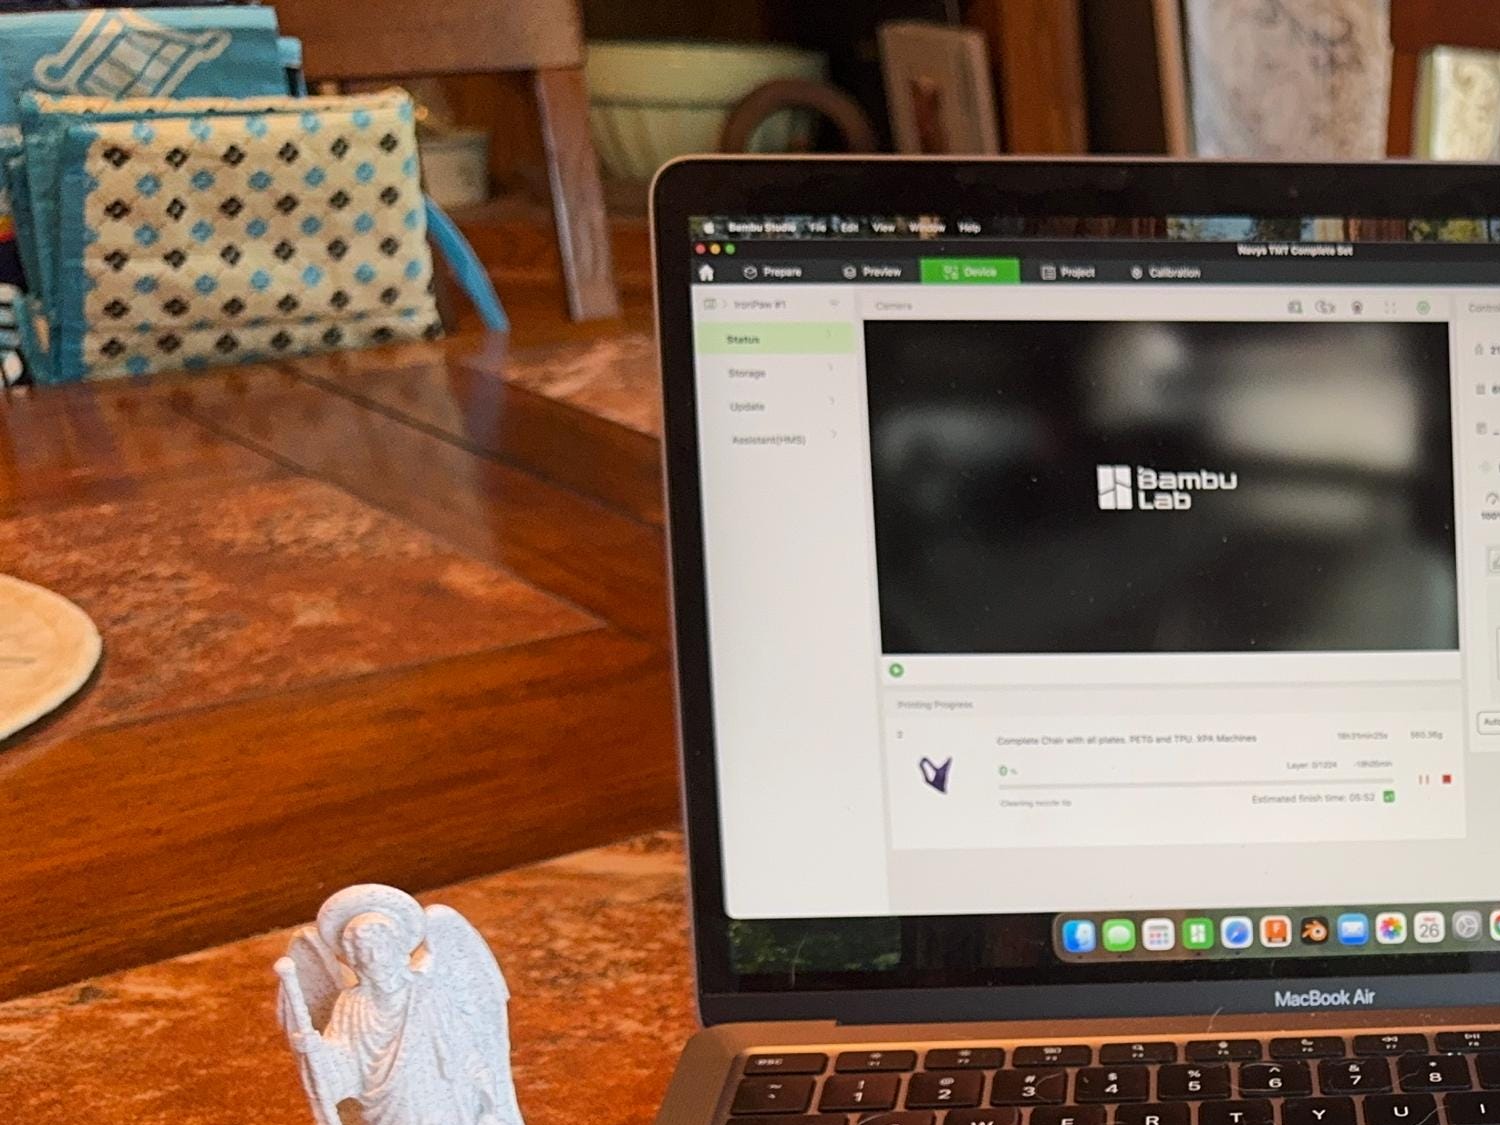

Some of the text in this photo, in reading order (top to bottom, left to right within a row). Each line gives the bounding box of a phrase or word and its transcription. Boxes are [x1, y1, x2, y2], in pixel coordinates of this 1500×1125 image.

[728, 222, 797, 232] Bambu Studio
[809, 223, 827, 232] File
[841, 223, 859, 232] Edit
[872, 223, 896, 232] View
[909, 223, 946, 232] Window
[958, 223, 982, 233] Help
[763, 266, 802, 278] Prepare
[862, 266, 902, 278] Preview
[964, 266, 997, 277] Device
[1060, 266, 1096, 279] Project
[1150, 266, 1201, 278] Calibration
[726, 335, 760, 345] Status
[728, 368, 767, 379] Storage
[730, 402, 765, 412] Update
[1137, 466, 1237, 490] Bambu
[1138, 490, 1192, 510] Lab
[996, 735, 1039, 746] Complete
[1041, 735, 1064, 745] Chair
[1066, 735, 1085, 745] with
[1155, 734, 1172, 744] and
[1251, 794, 1297, 804] Estimated
[1299, 793, 1323, 803] finish
[1420, 923, 1440, 938] 26
[1274, 988, 1376, 1008] MacBook Air
[1268, 1077, 1283, 1088] 6
[1350, 1075, 1362, 1085] 7
[1429, 1072, 1443, 1083] 8
[1105, 1083, 1118, 1094] 4
[1188, 1080, 1201, 1091] 5
[854, 1091, 863, 1102] 1
[938, 1088, 952, 1100] 2
[1022, 1086, 1036, 1097] 3
[1393, 1106, 1409, 1117] U
[1480, 1103, 1486, 1114] I
[1229, 1112, 1243, 1123] T
[1312, 1109, 1326, 1120] Y
